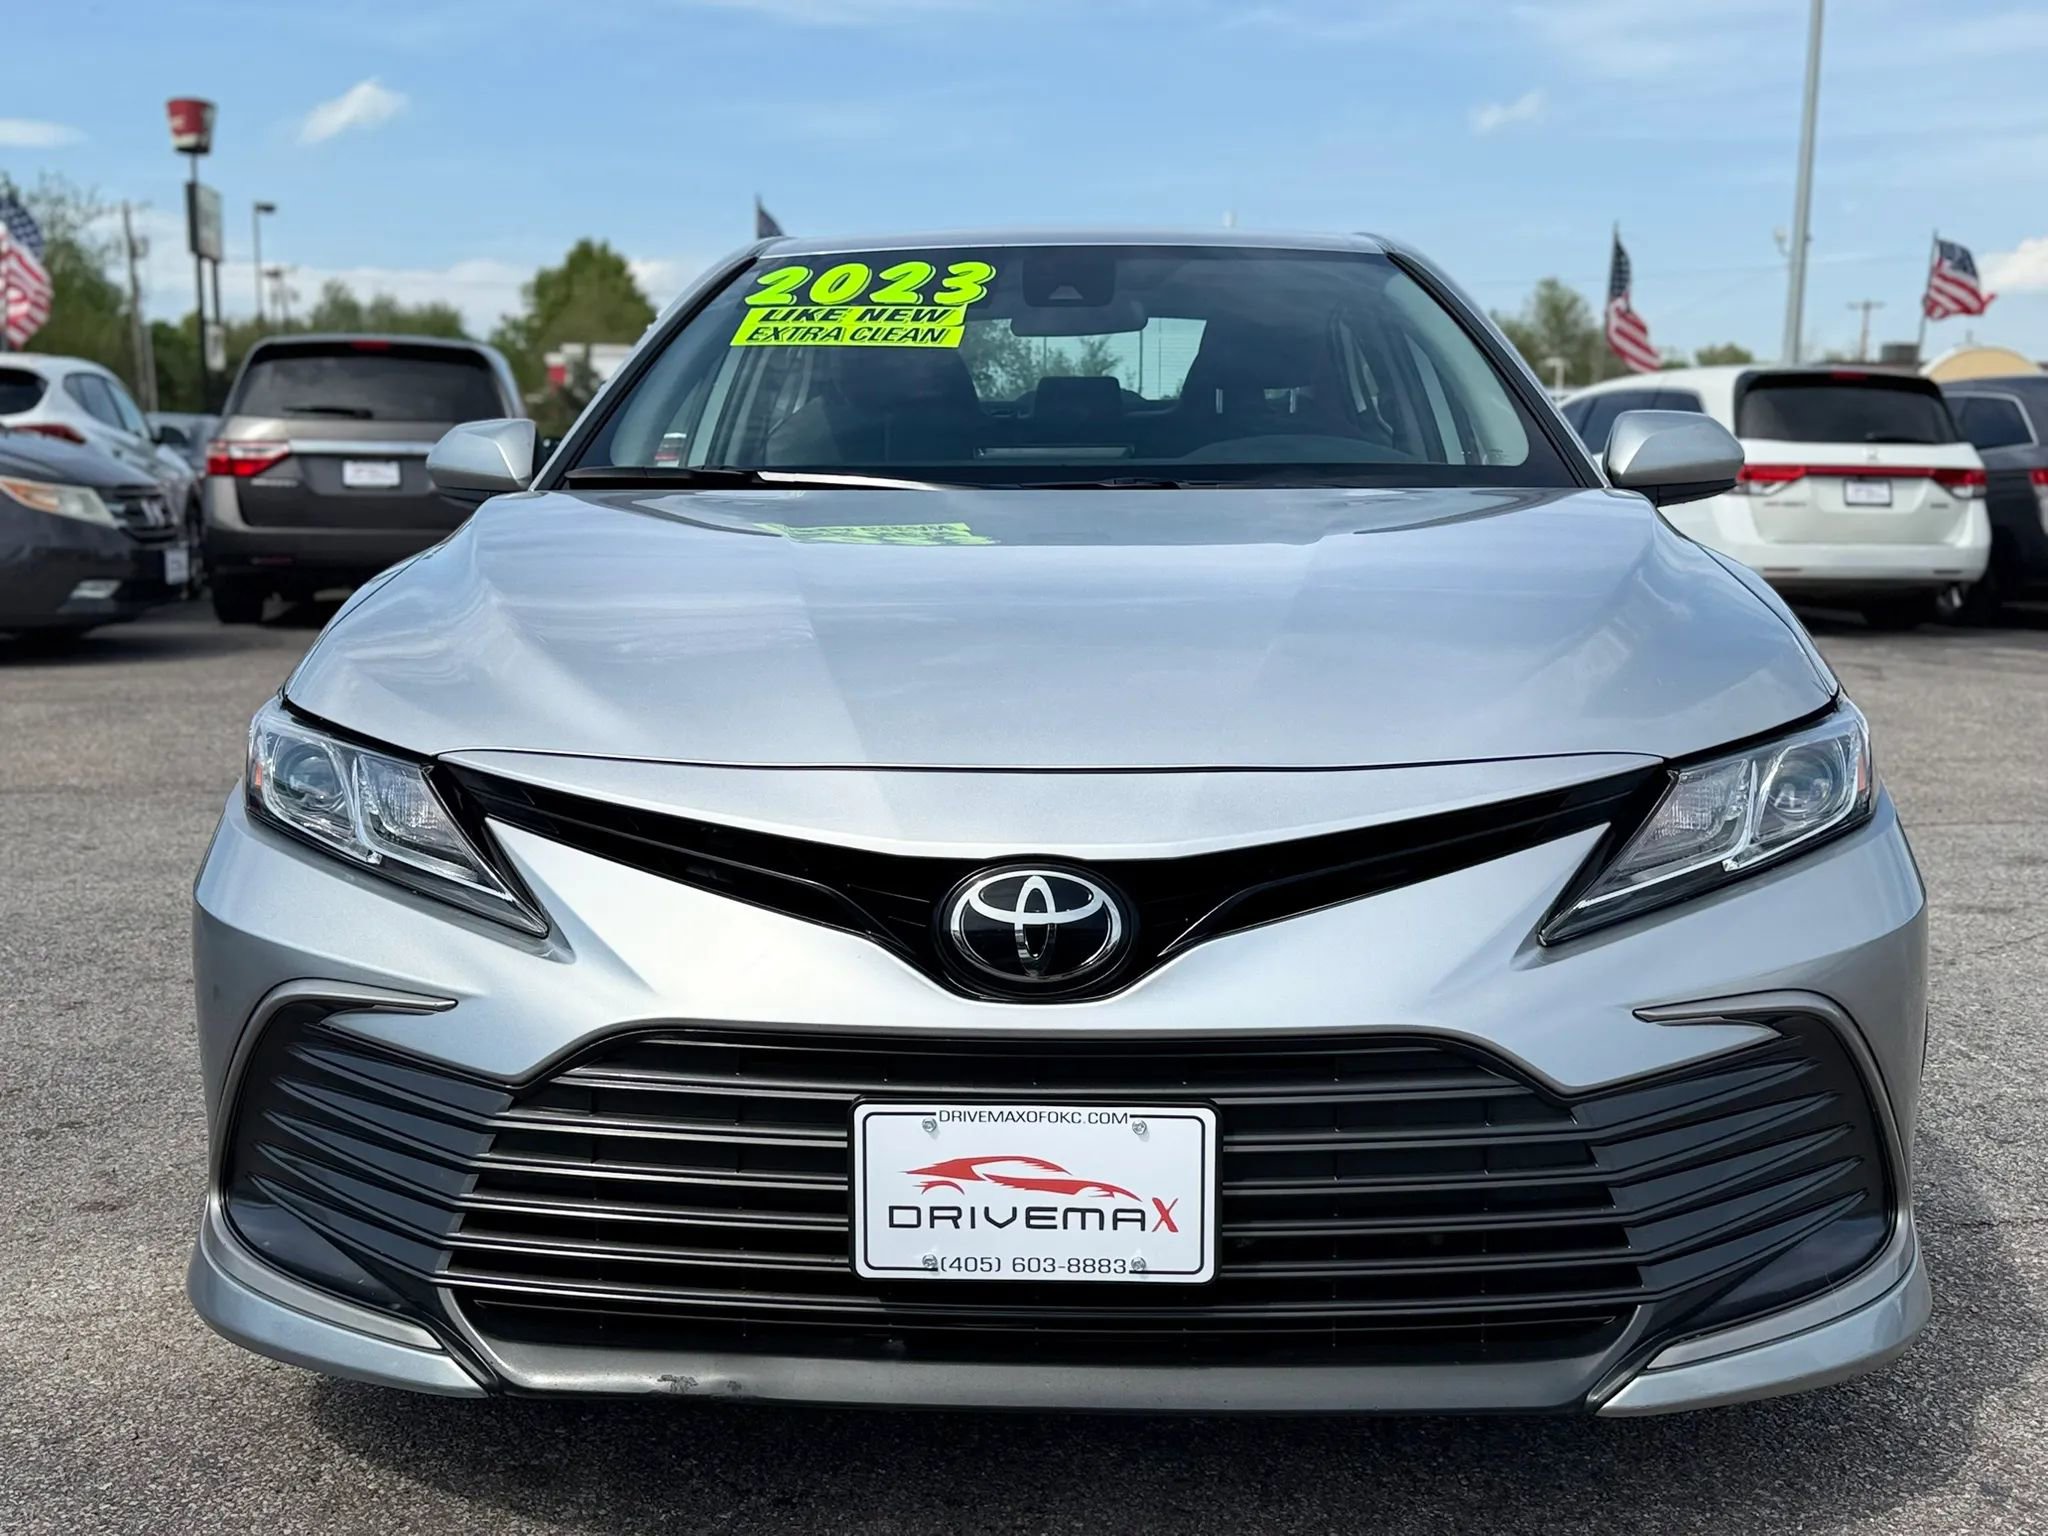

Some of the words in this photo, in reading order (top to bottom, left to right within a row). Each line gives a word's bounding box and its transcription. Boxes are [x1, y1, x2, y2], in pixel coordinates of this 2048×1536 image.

[744, 261, 996, 306] 2023
[758, 308, 850, 323] LIKE
[856, 308, 954, 323] NEW
[746, 326, 845, 342] EXTRA
[849, 327, 950, 343] CLEAN
[938, 1109, 1129, 1125] DRIVEMAXOFOKC.COM
[888, 1197, 1179, 1233] DRIVEMAX
[940, 1256, 1002, 1274] (405)
[1012, 1257, 1127, 1275] 603-8883
